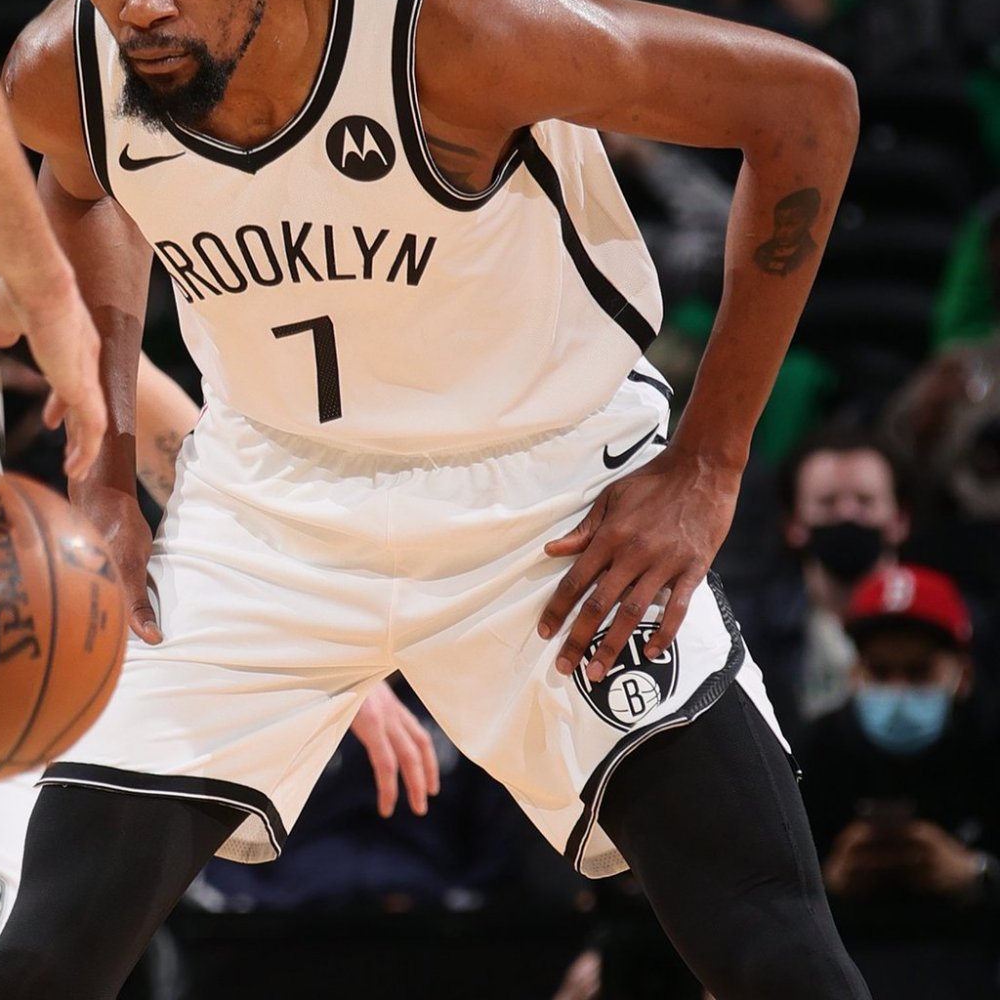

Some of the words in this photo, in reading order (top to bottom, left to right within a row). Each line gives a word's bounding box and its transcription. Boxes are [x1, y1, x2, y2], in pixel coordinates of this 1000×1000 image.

[154, 220, 438, 304] ROOKLYN
[271, 314, 343, 424] 7
[622, 678, 646, 717] B
